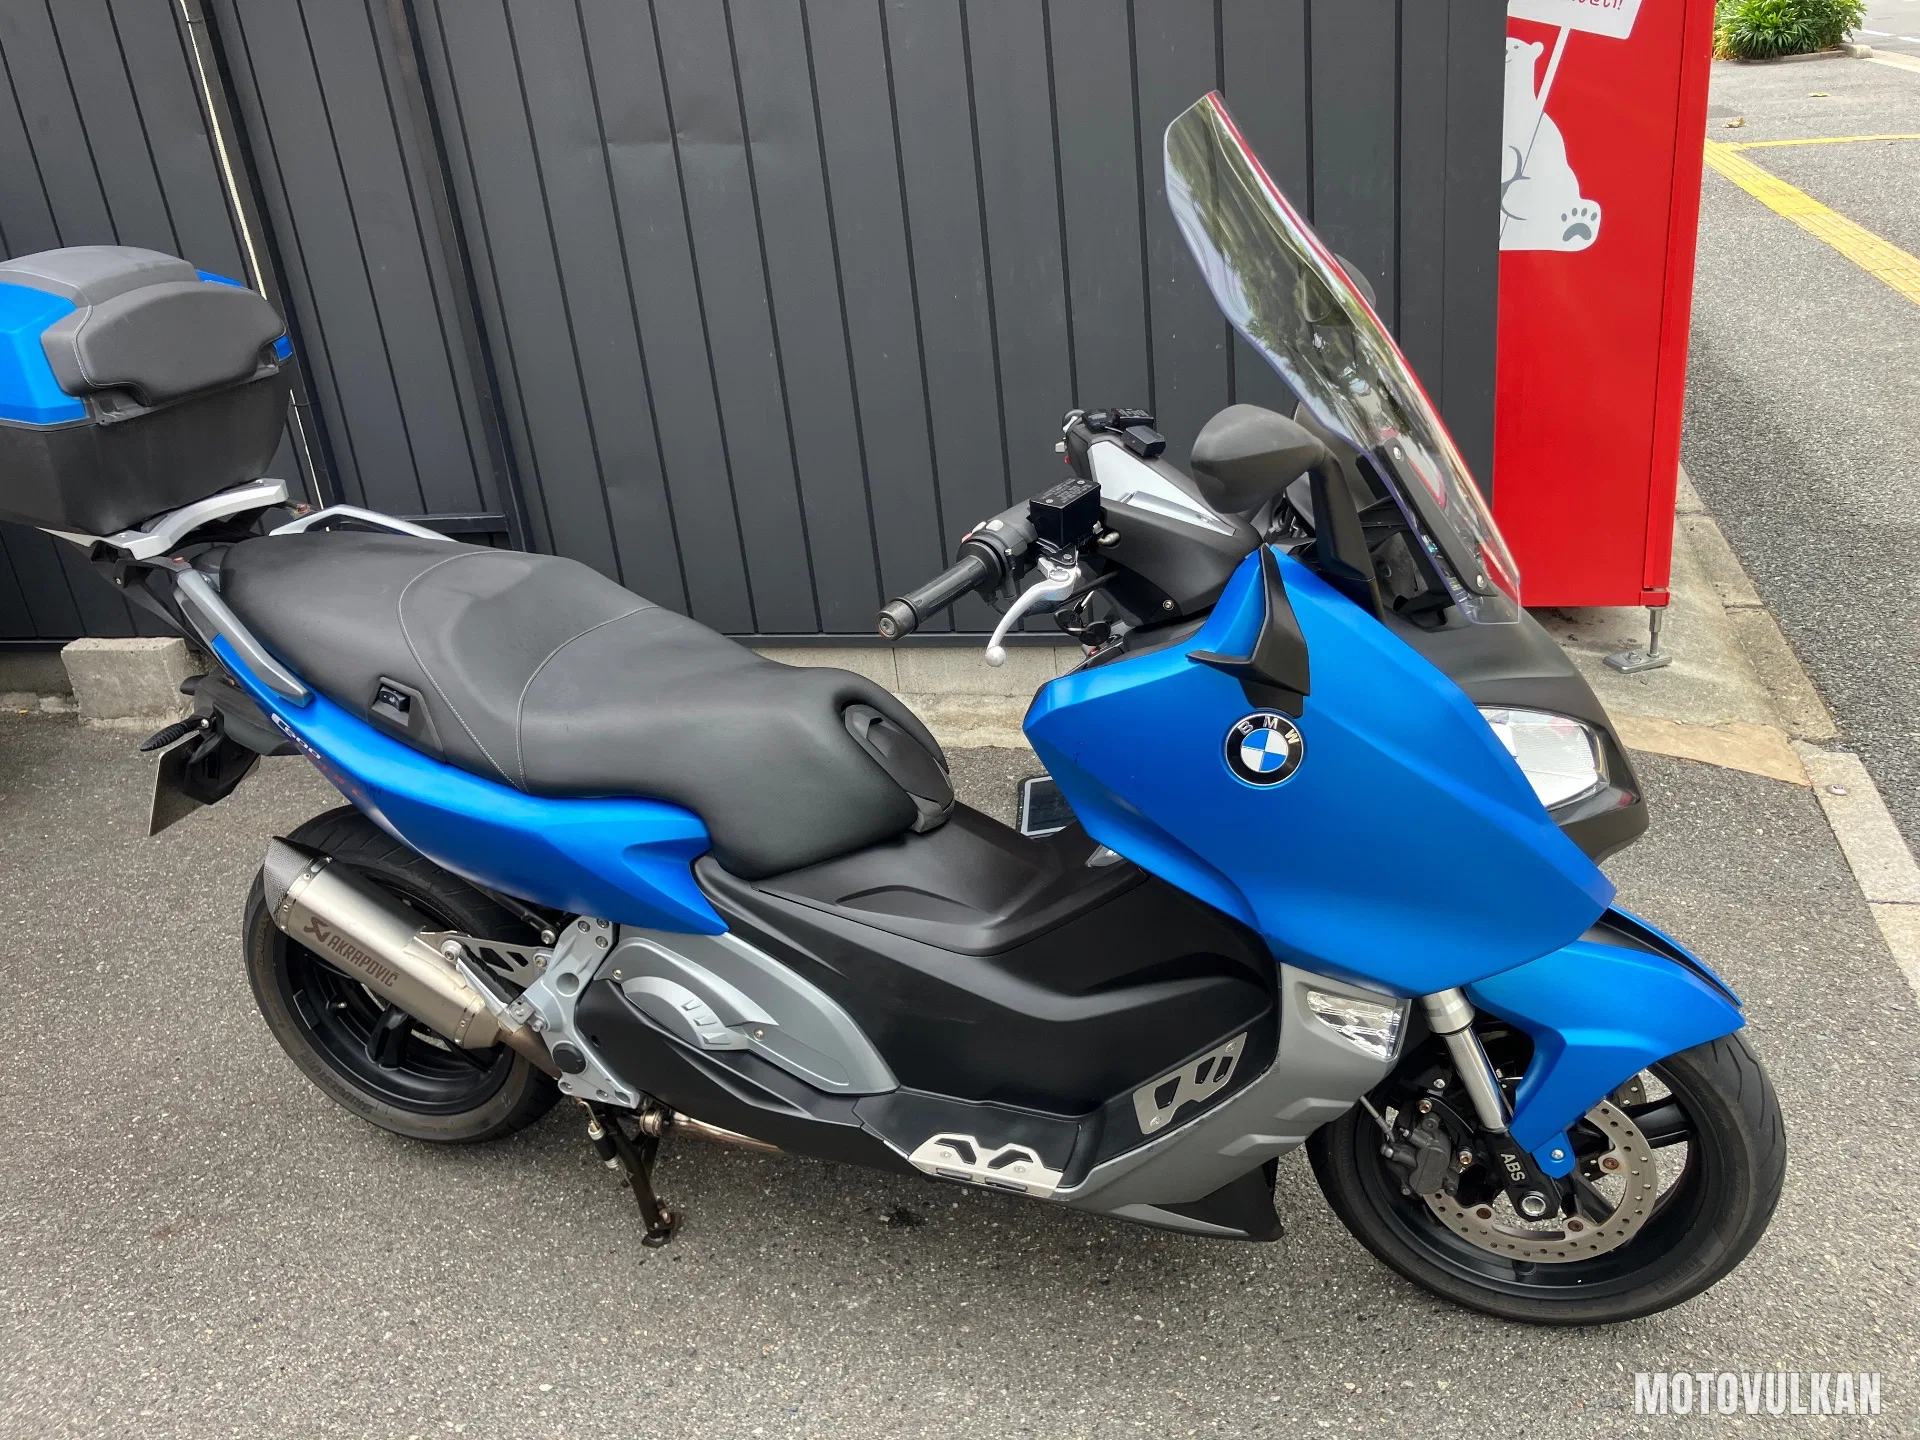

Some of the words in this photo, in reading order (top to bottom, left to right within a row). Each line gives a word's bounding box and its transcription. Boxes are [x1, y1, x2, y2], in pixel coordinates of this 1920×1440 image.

[1237, 715, 1300, 745] BMW
[326, 934, 400, 988] AKRAPOVIČ
[1500, 1153, 1526, 1182] ABS
